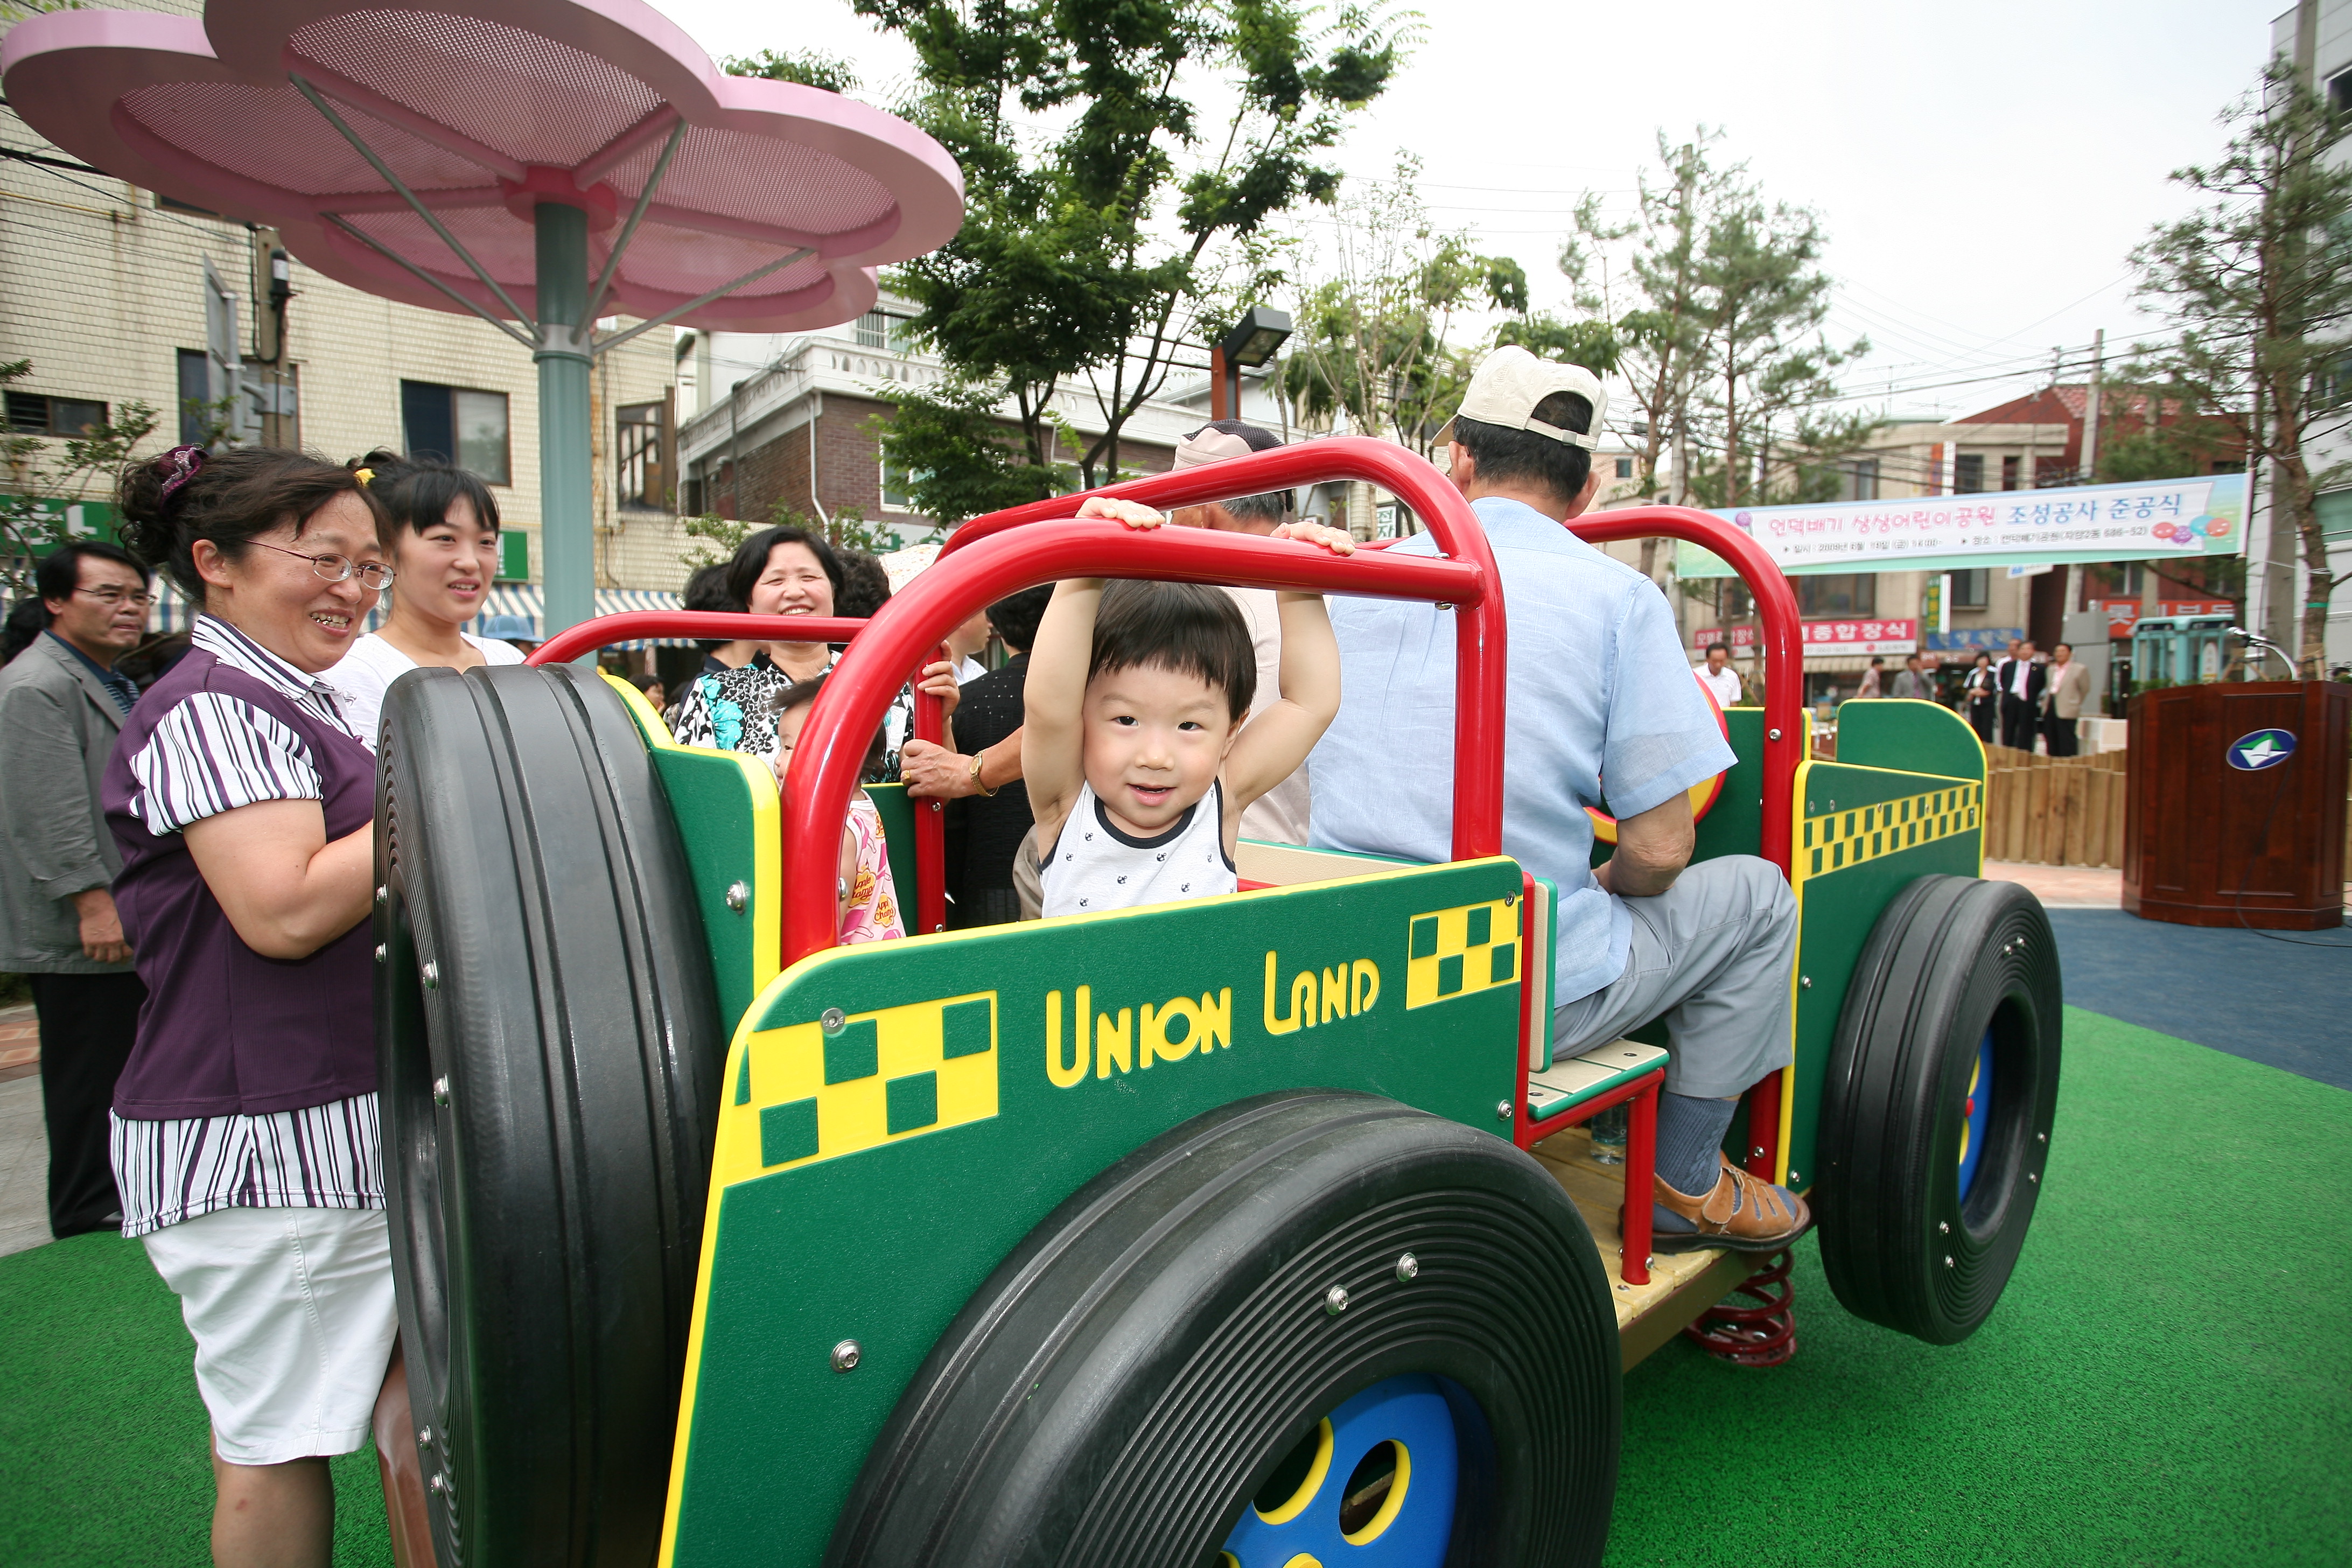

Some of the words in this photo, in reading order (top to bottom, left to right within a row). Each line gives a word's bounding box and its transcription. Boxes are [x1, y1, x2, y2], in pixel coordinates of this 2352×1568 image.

[1768, 519, 1844, 536] 언덕배기
[1851, 506, 1997, 535] 상상어린이공원
[2007, 500, 2097, 525] 조성공사
[2107, 494, 2181, 519] 준공식
[1046, 985, 1232, 1089] UNION
[1264, 950, 1380, 1035] LAND
